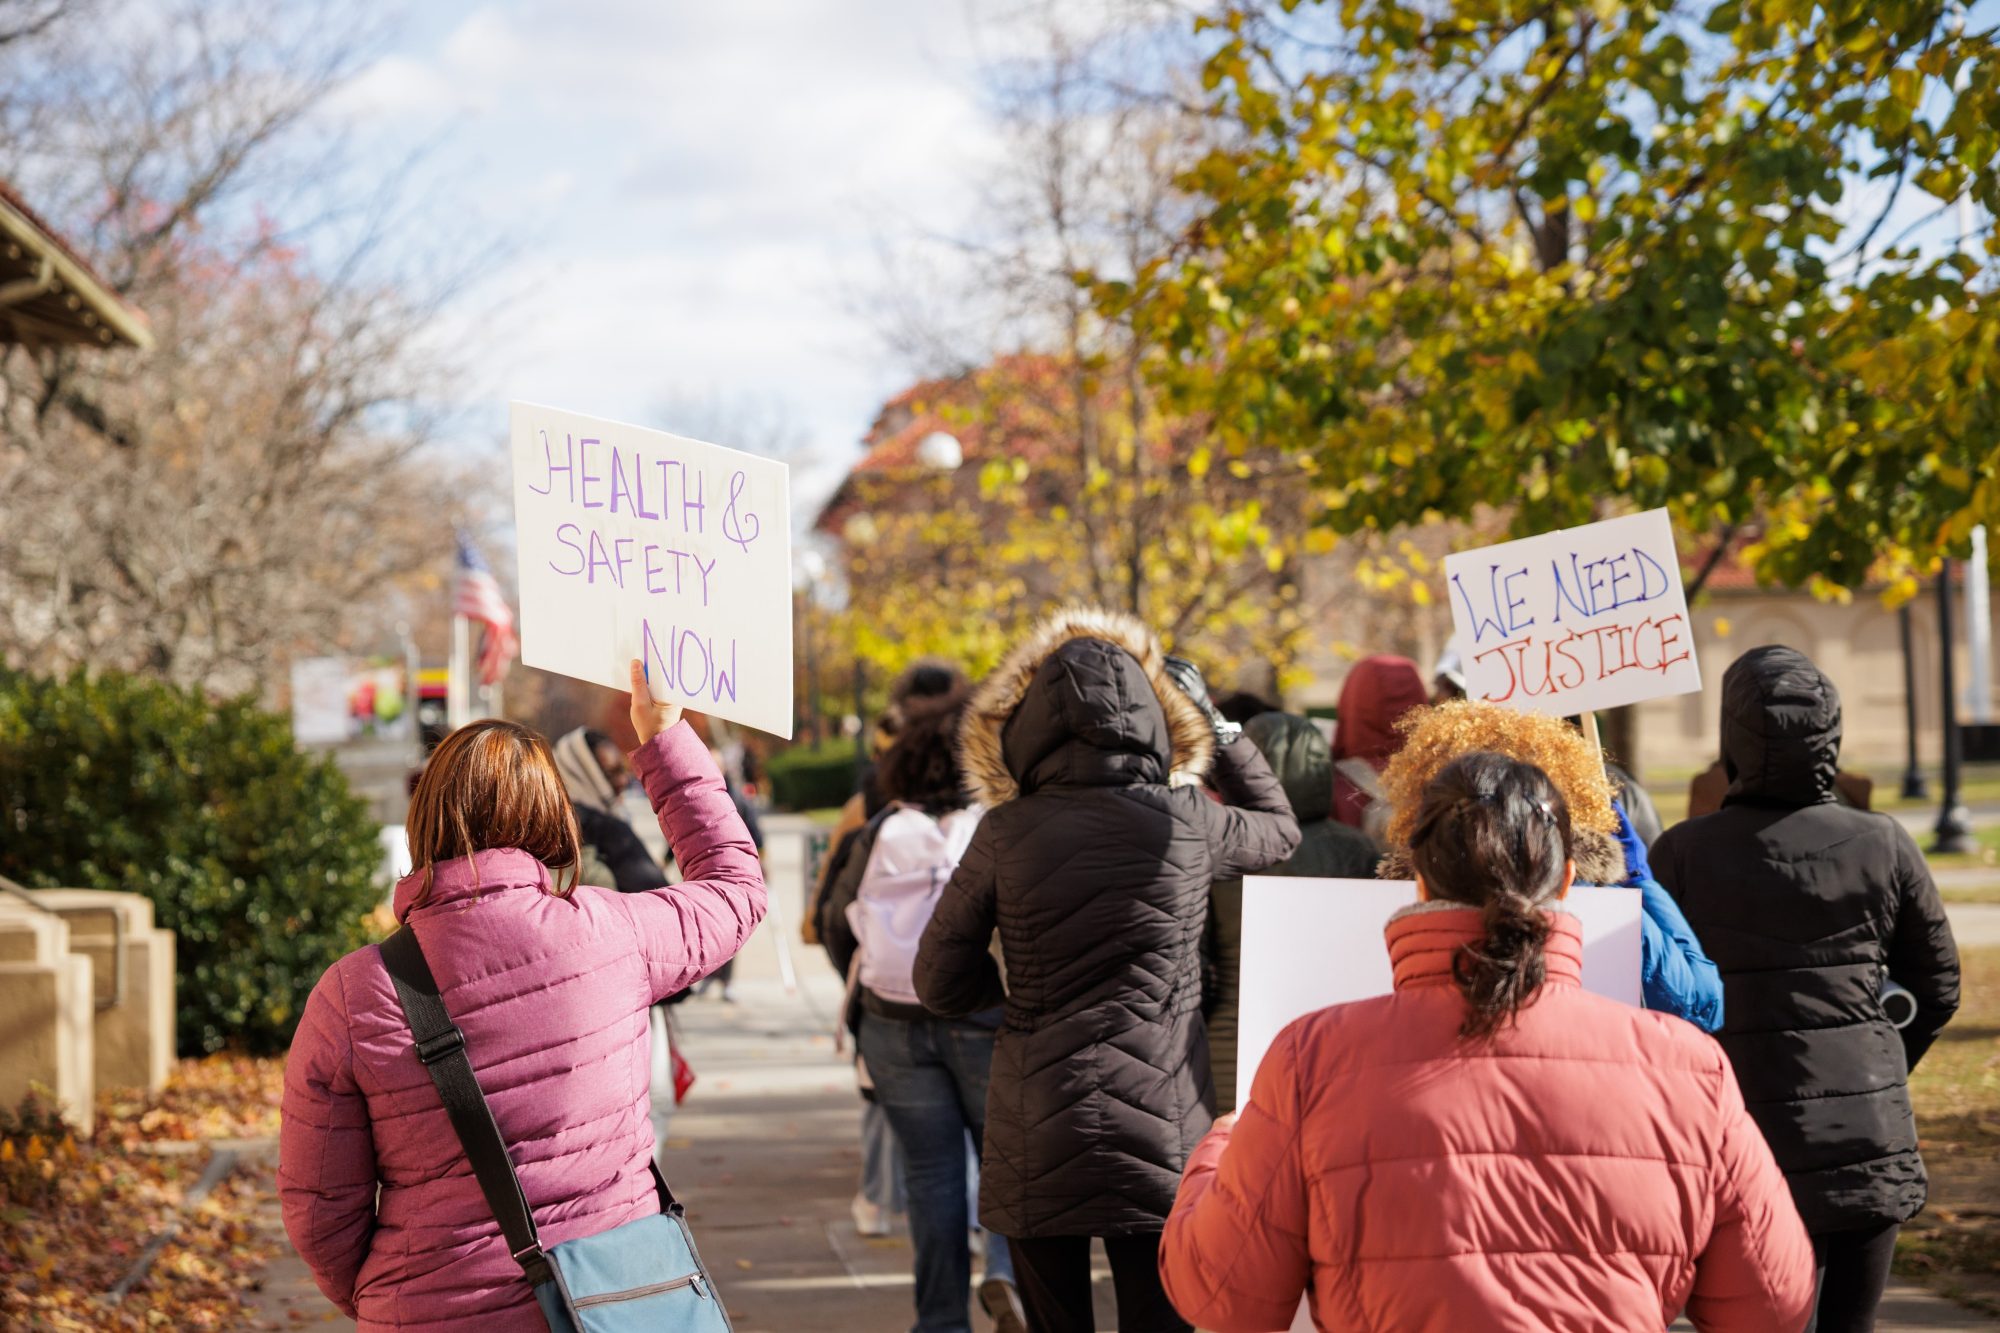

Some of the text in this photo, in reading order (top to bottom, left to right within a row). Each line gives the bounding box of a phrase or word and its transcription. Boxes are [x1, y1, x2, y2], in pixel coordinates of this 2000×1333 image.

[529, 430, 759, 553] HEALTH &
[549, 524, 715, 606] SAFETY
[1452, 547, 1668, 643] WE NEED
[643, 618, 736, 703] NOW
[1474, 613, 1689, 702] JUSTICE
